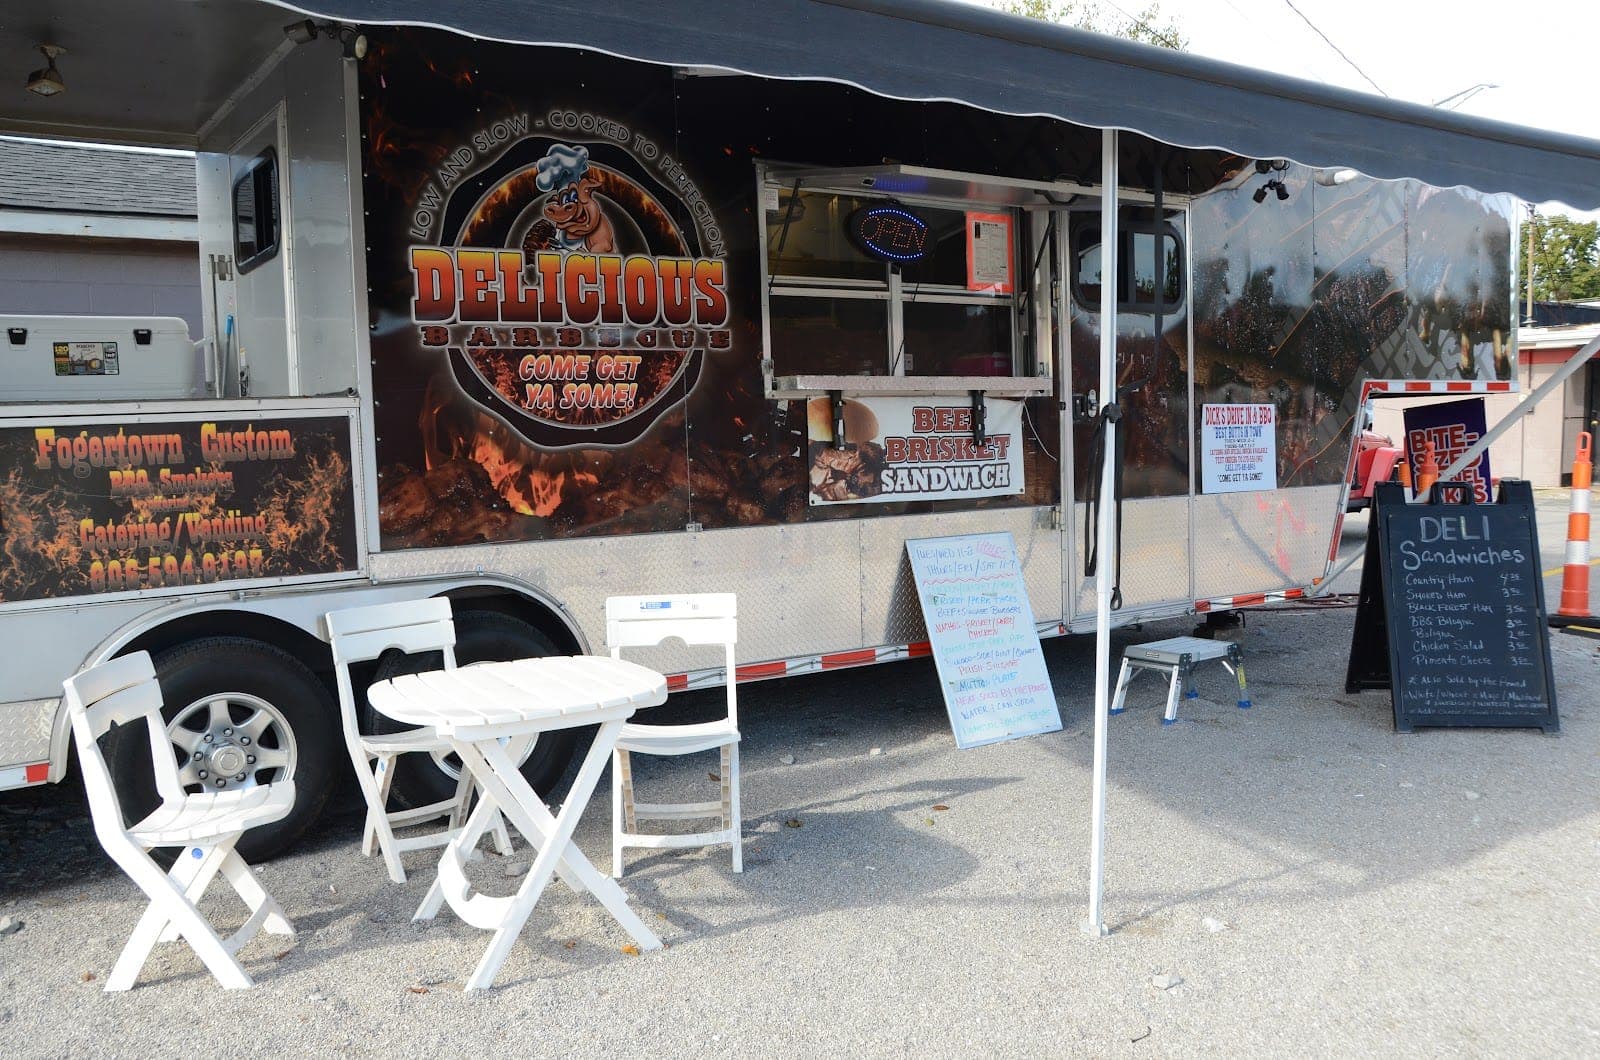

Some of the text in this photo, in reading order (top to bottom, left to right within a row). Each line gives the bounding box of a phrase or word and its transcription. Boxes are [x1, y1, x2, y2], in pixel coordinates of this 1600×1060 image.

[411, 186, 441, 239] LOW
[440, 148, 473, 186] AND
[474, 115, 527, 151] SLOW
[549, 111, 629, 142] COOKED
[634, 135, 657, 158] TO
[659, 156, 727, 258] PERFECTION
[861, 215, 929, 251] OPEN
[411, 247, 728, 326] DELICIOUS
[519, 354, 642, 381] COME GET
[525, 382, 638, 410] YA SOME!
[1226, 406, 1244, 425] DRIVE
[1245, 406, 1252, 425] IN
[35, 423, 296, 478] Fogertown Custom
[885, 434, 1011, 463] BRISKET
[881, 463, 1011, 493] SANDWICH
[80, 510, 267, 551] Catering/Vending
[1420, 515, 1490, 543] DELI
[1400, 540, 1525, 570] Sandwiches
[1405, 572, 1446, 590] Country
[1447, 573, 1475, 585] Ham
